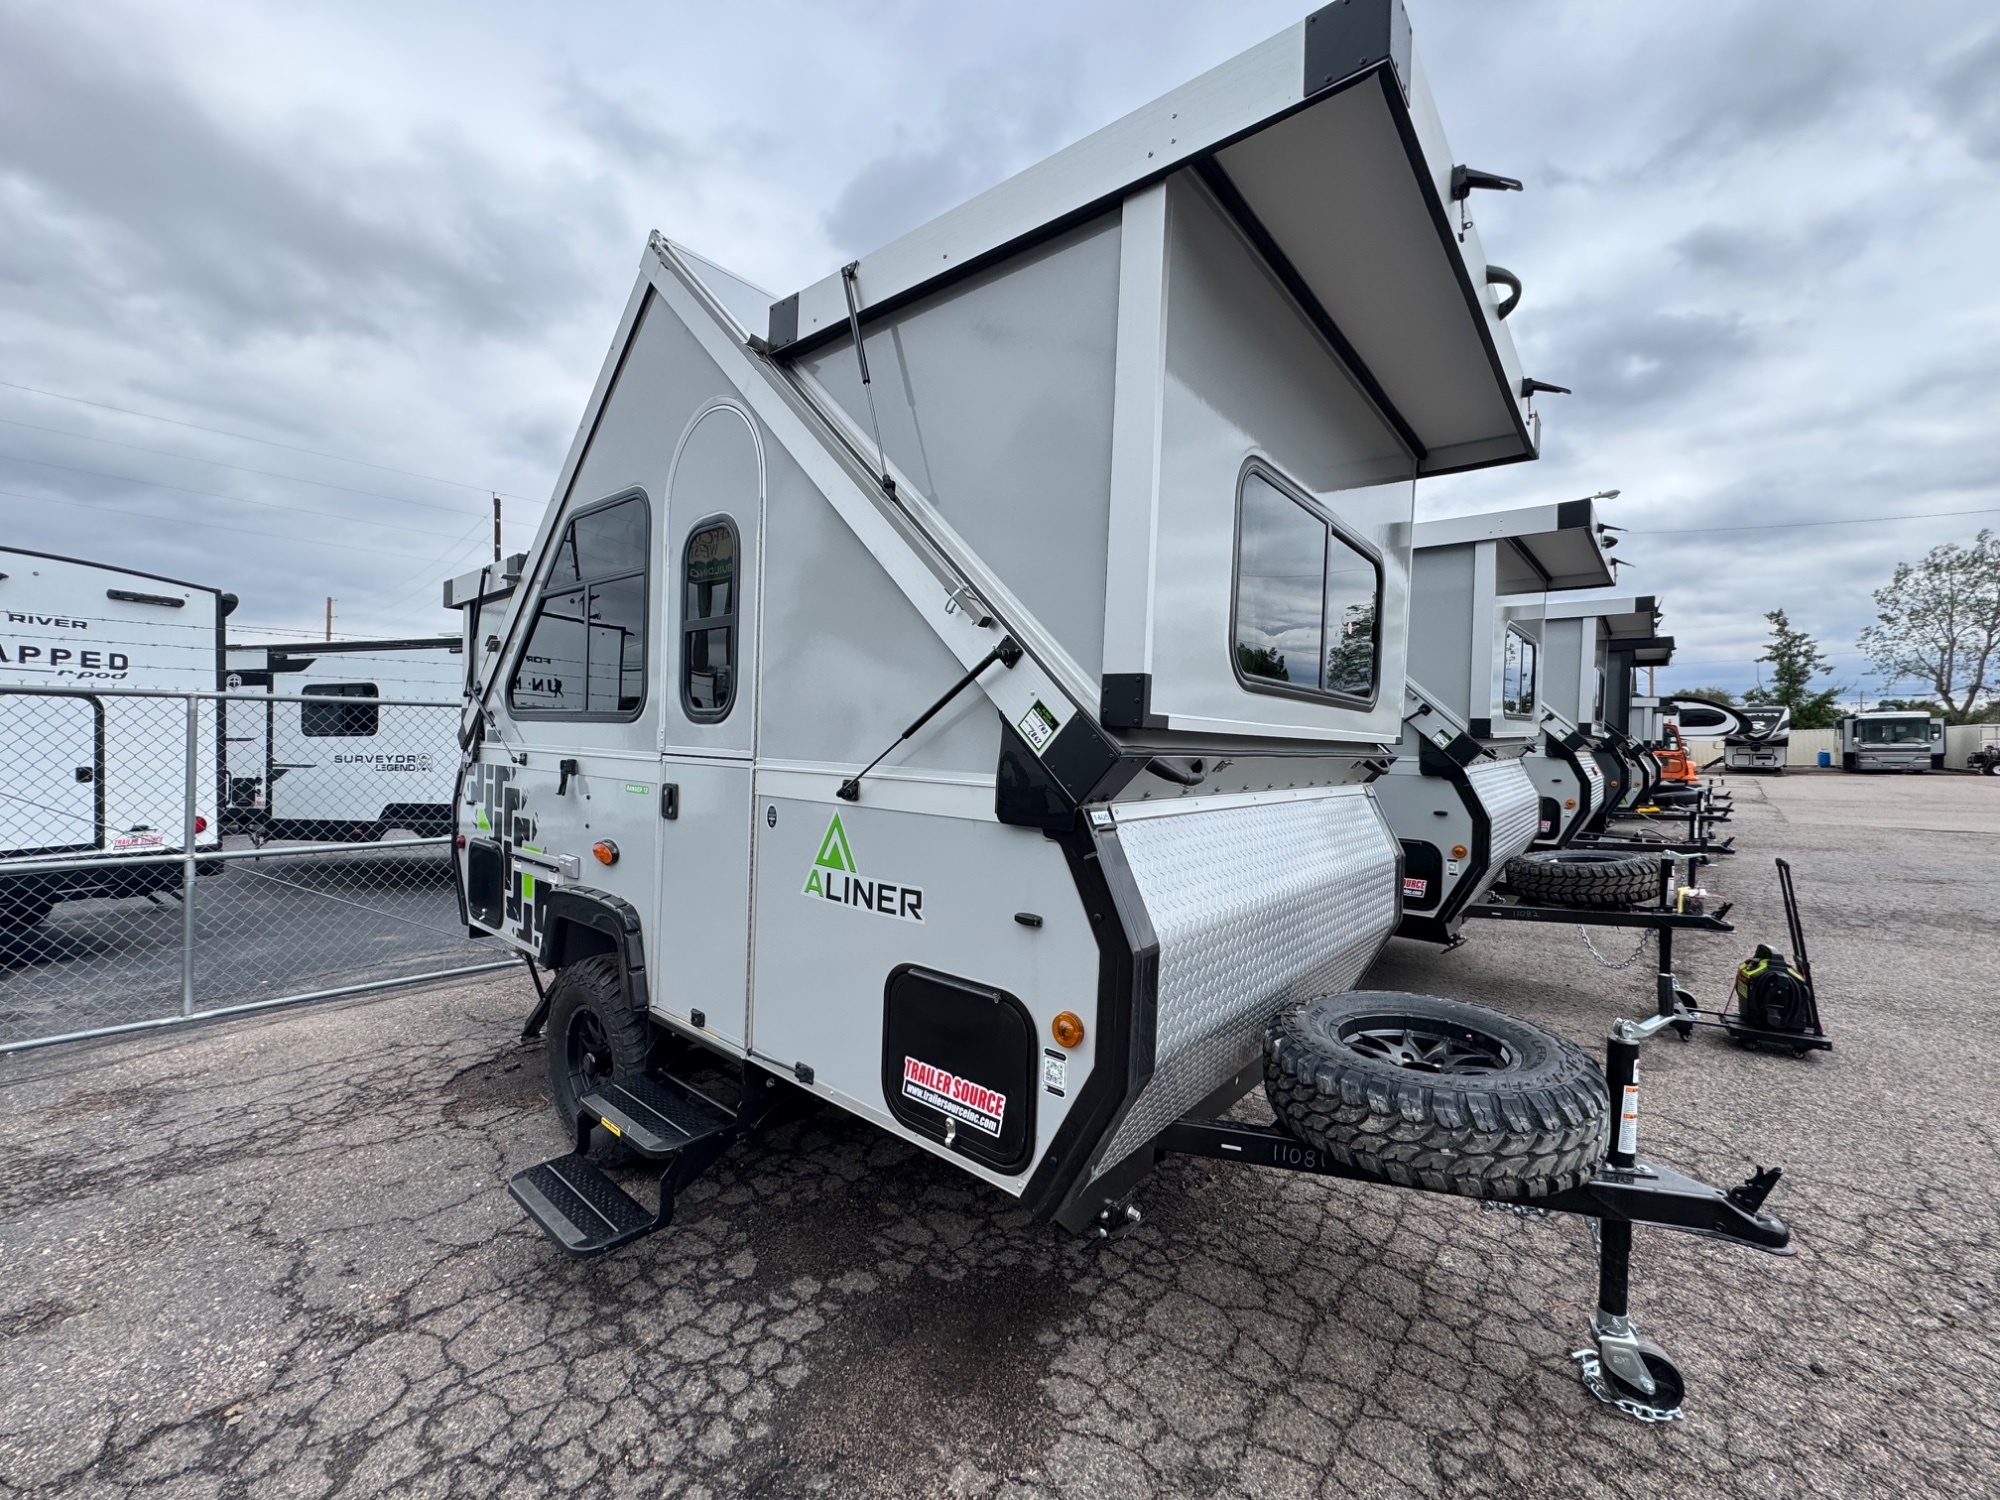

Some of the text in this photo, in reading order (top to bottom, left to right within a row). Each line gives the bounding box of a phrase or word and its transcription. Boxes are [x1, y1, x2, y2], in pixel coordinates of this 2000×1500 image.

[8, 613, 88, 630] RIVER
[334, 754, 416, 764] SURVEYOR
[375, 764, 416, 772] LEGEND
[804, 868, 923, 921] ALINER
[905, 1058, 1004, 1117] TRAILER SOURCE
[906, 1084, 997, 1132] www.trailersourceinc.com
[1273, 1144, 1326, 1168] 11081
